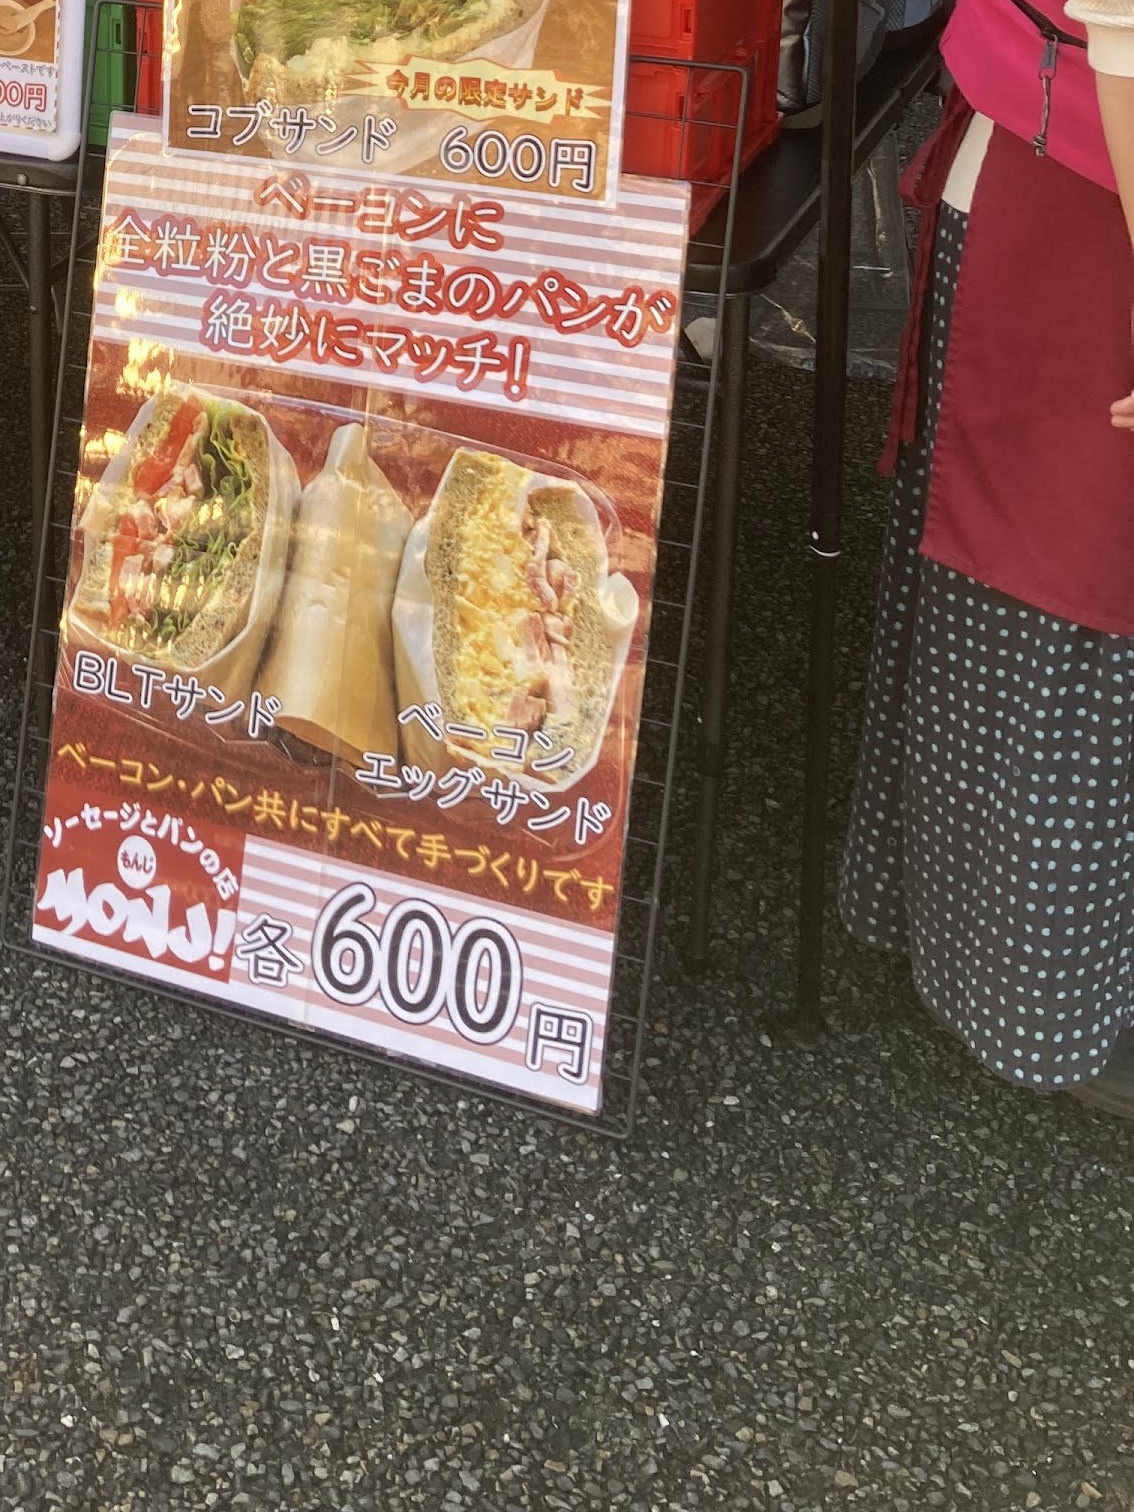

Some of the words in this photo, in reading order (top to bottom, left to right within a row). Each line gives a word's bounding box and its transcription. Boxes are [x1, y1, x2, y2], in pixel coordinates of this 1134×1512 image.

[384, 68, 586, 114] 今月の限定サンド
[185, 99, 398, 165] コブサンド
[439, 125, 598, 193] 600円
[104, 215, 674, 345] 全粒粉と黒ごまのパンが
[72, 649, 284, 739] BLTサンド
[398, 699, 576, 772] ベーコン
[56, 740, 616, 913] ベーコン・パン共にすべて手づくりです
[355, 749, 613, 846] エッグサンド
[42, 799, 240, 902] ソーセージとパンの店
[118, 848, 156, 877] もんじ
